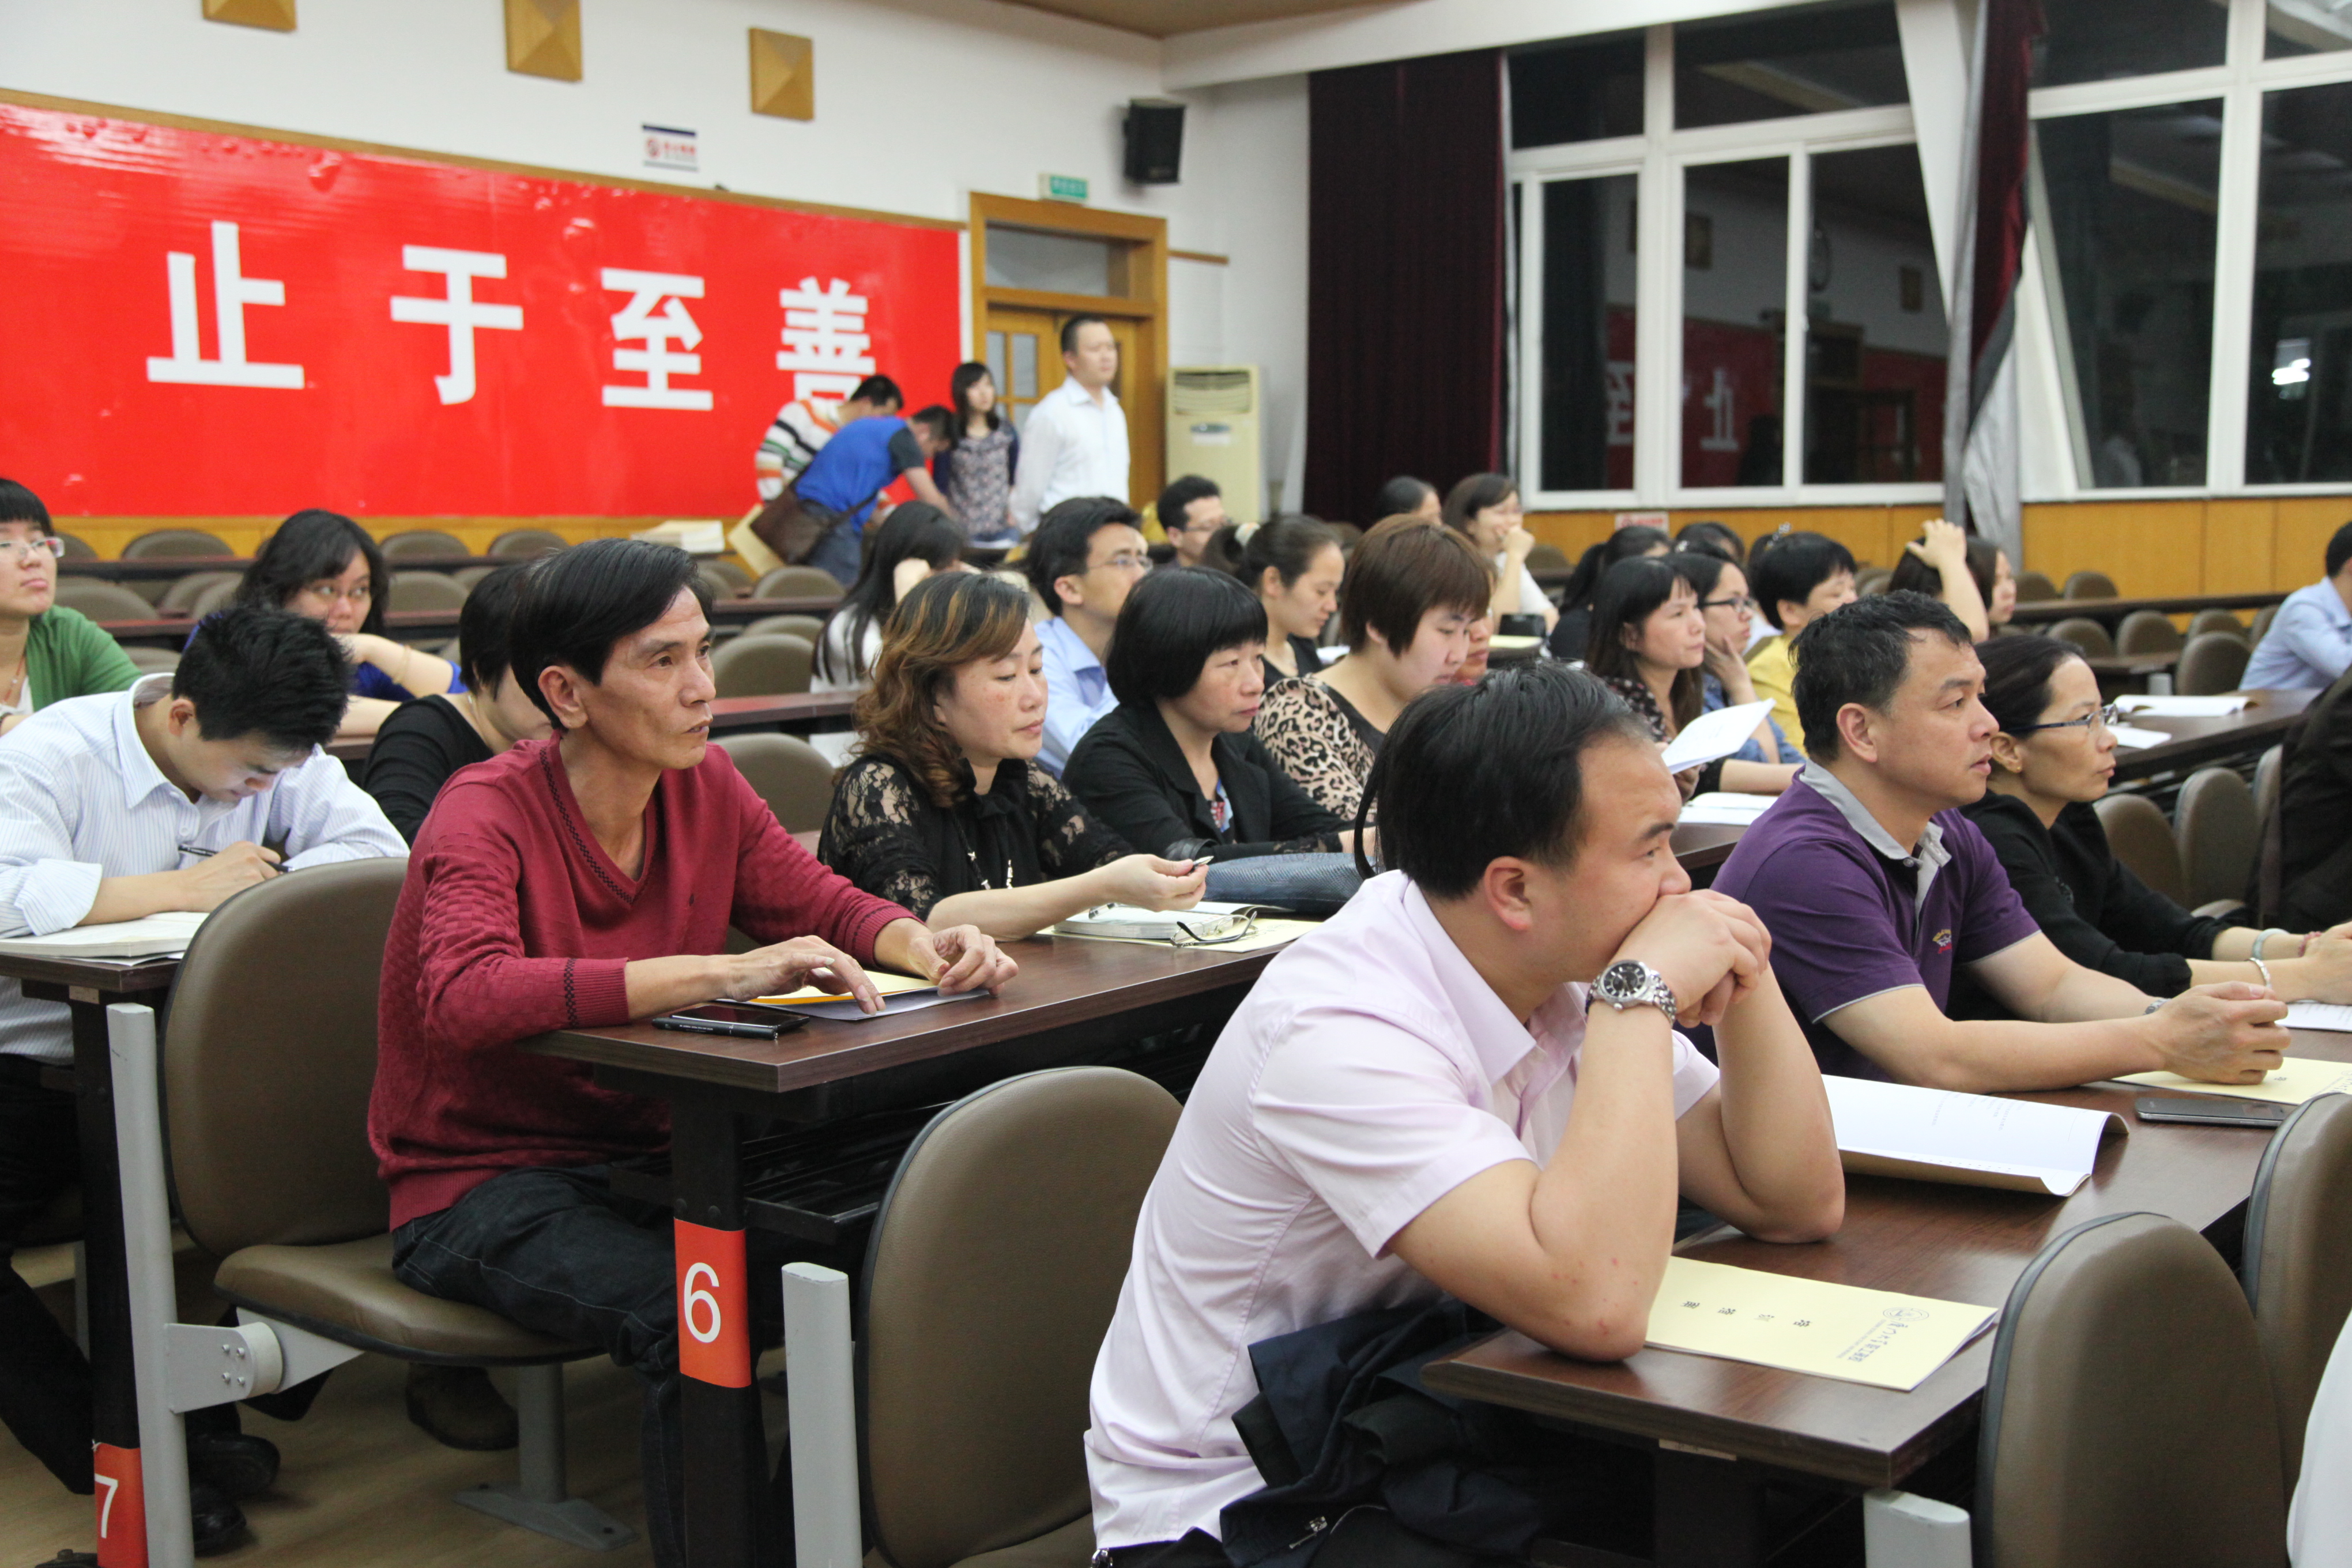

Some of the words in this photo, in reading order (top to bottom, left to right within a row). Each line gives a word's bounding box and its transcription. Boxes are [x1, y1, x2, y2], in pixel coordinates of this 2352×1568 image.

[146, 220, 876, 410] 止于至善
[684, 1262, 721, 1343] 6
[94, 1473, 119, 1539] 7
